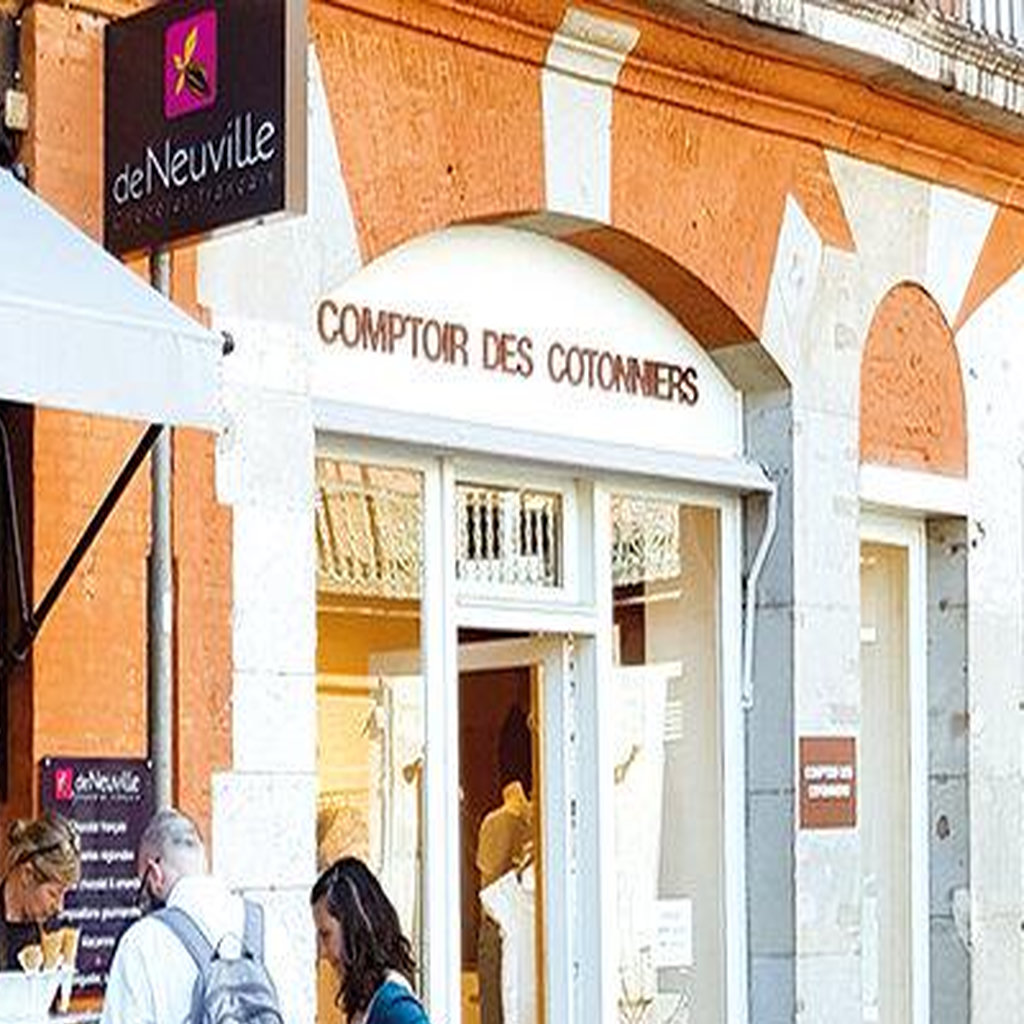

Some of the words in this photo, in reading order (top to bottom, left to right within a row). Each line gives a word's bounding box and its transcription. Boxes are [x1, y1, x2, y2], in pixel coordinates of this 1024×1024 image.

[112, 112, 275, 205] deNeuville
[316, 299, 469, 367] COMPTOIR
[482, 329, 534, 379] DES
[546, 342, 699, 406] COTONNIERS
